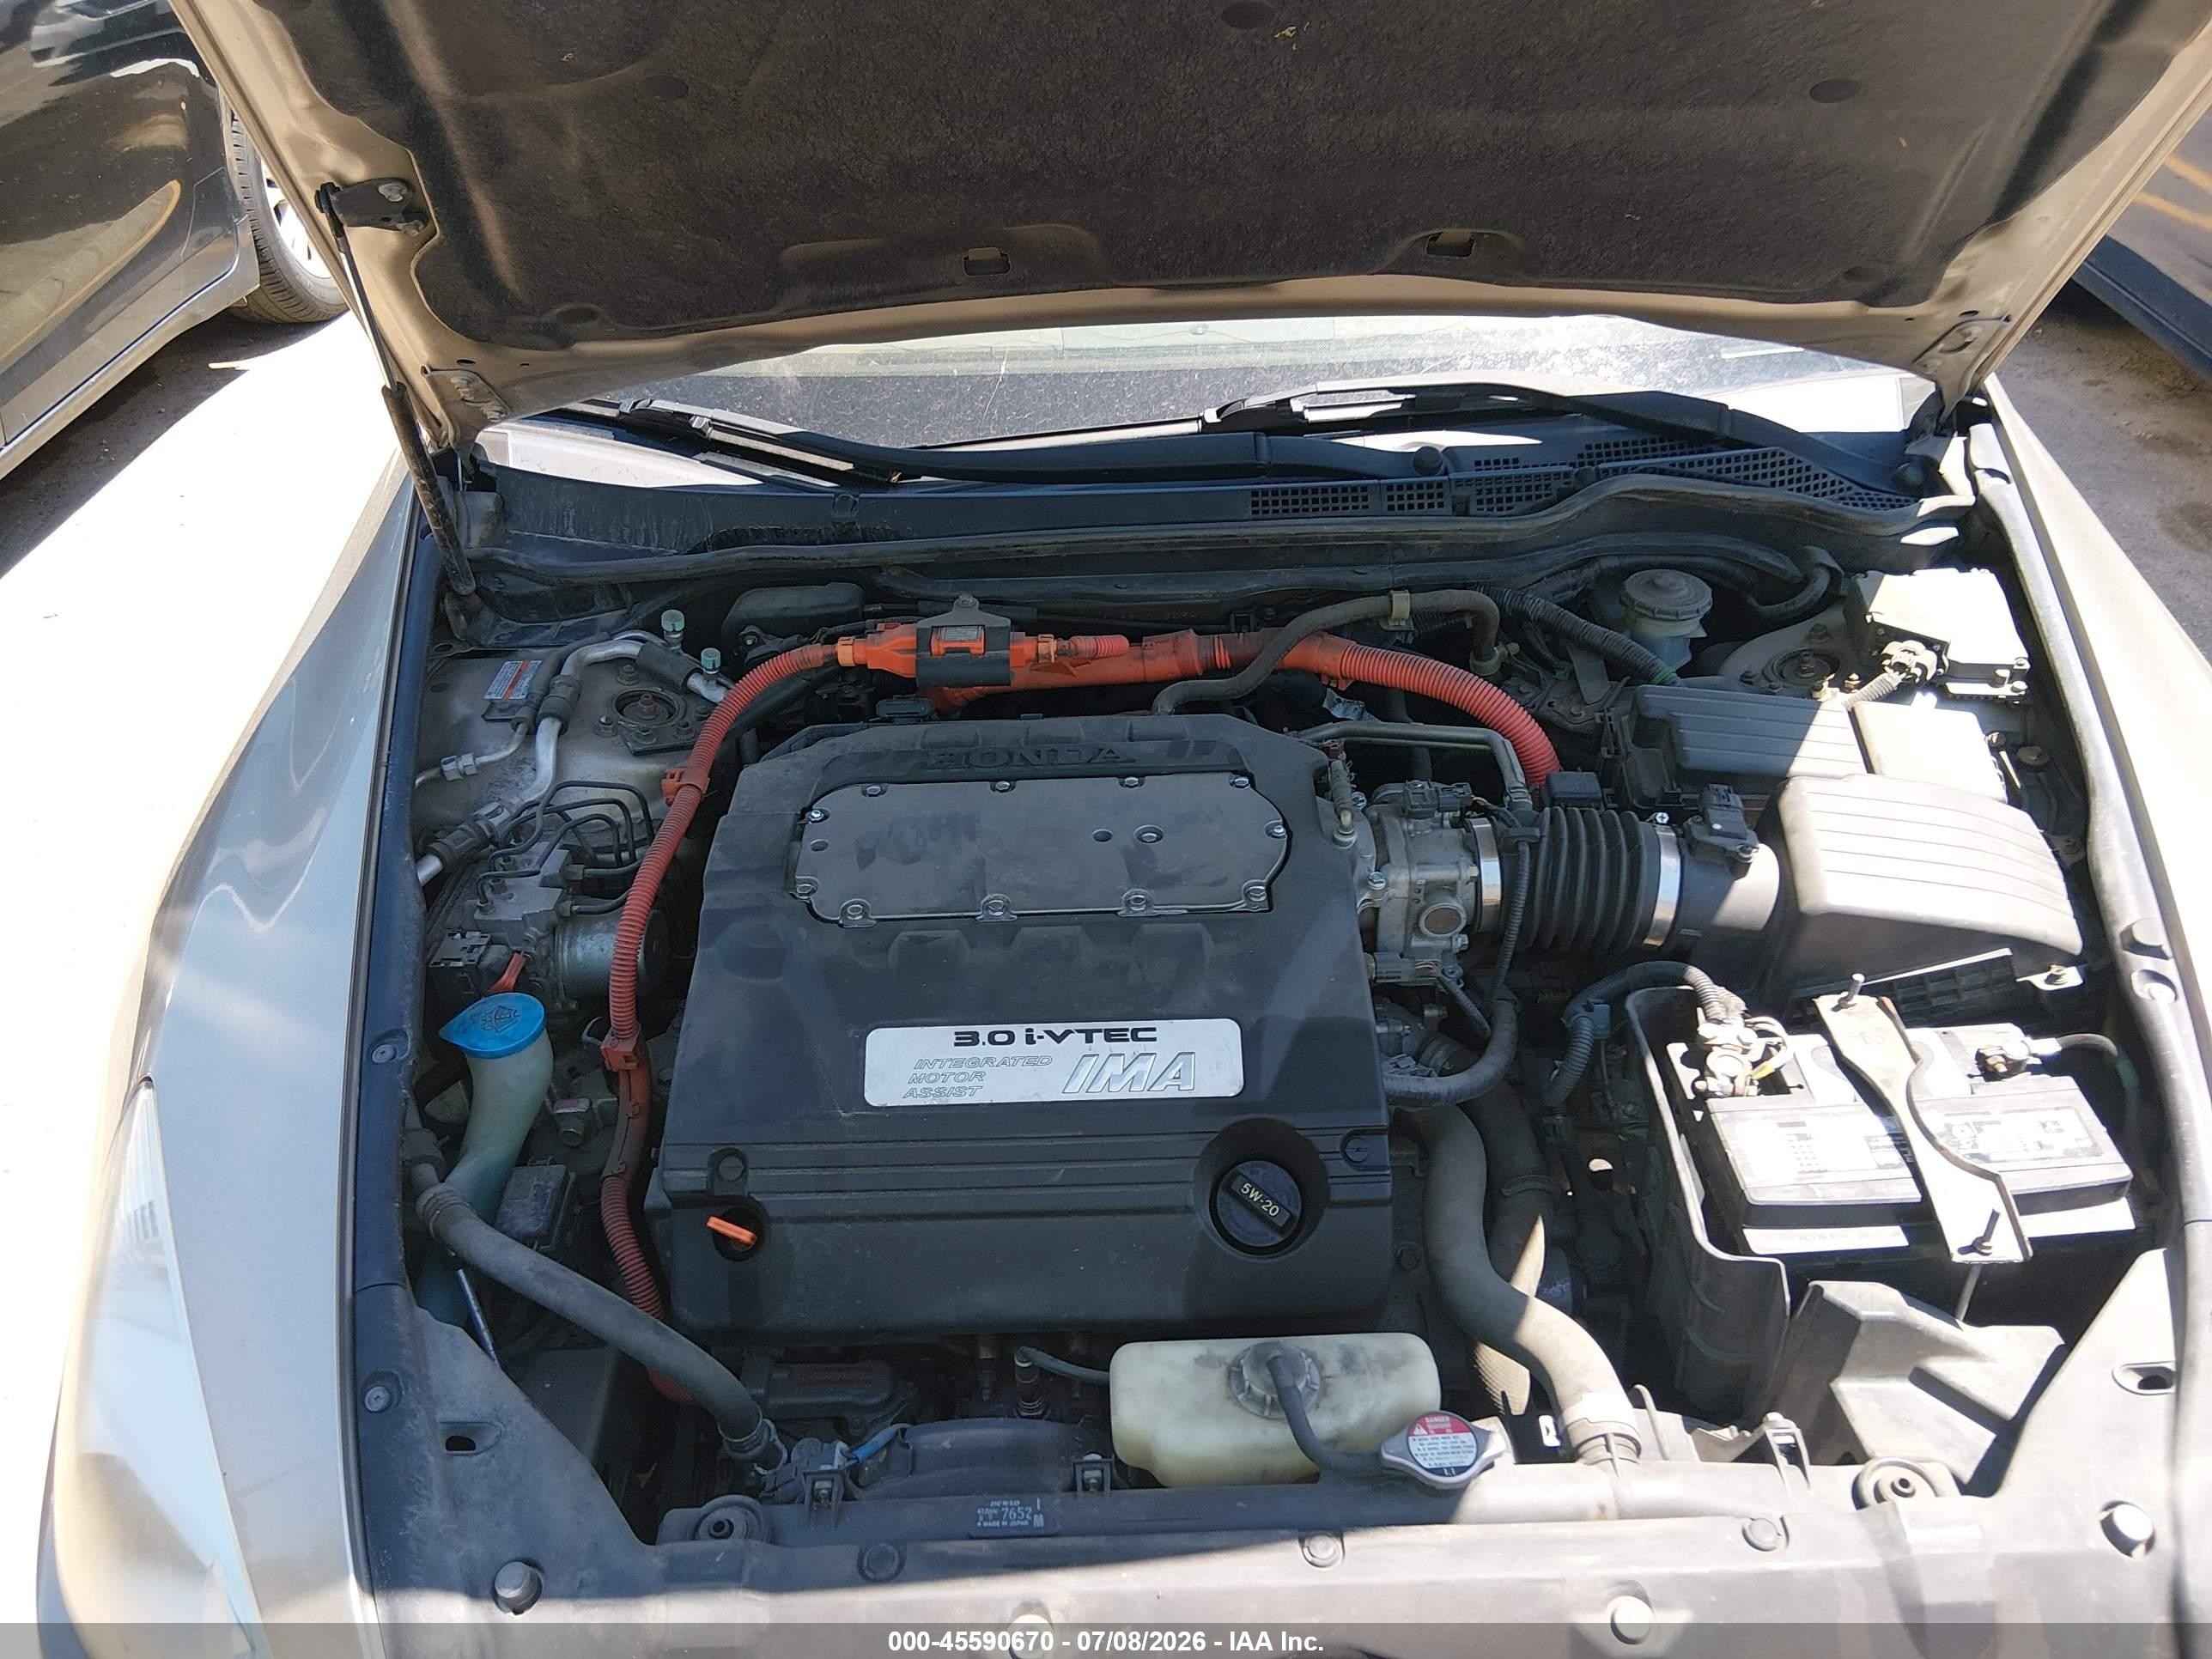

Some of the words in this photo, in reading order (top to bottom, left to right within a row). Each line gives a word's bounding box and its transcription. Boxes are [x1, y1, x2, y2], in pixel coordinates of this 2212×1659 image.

[924, 746, 1137, 770] HONDA
[953, 1027, 1016, 1047] 3.0
[1024, 1026, 1158, 1046] i-VTEC
[913, 1054, 1054, 1070] INTEGRATED
[908, 1071, 987, 1085] MOTOR
[1061, 1051, 1197, 1095] IMA
[902, 1085, 983, 1099] ASSIST
[1241, 1182, 1279, 1216] 5W-20
